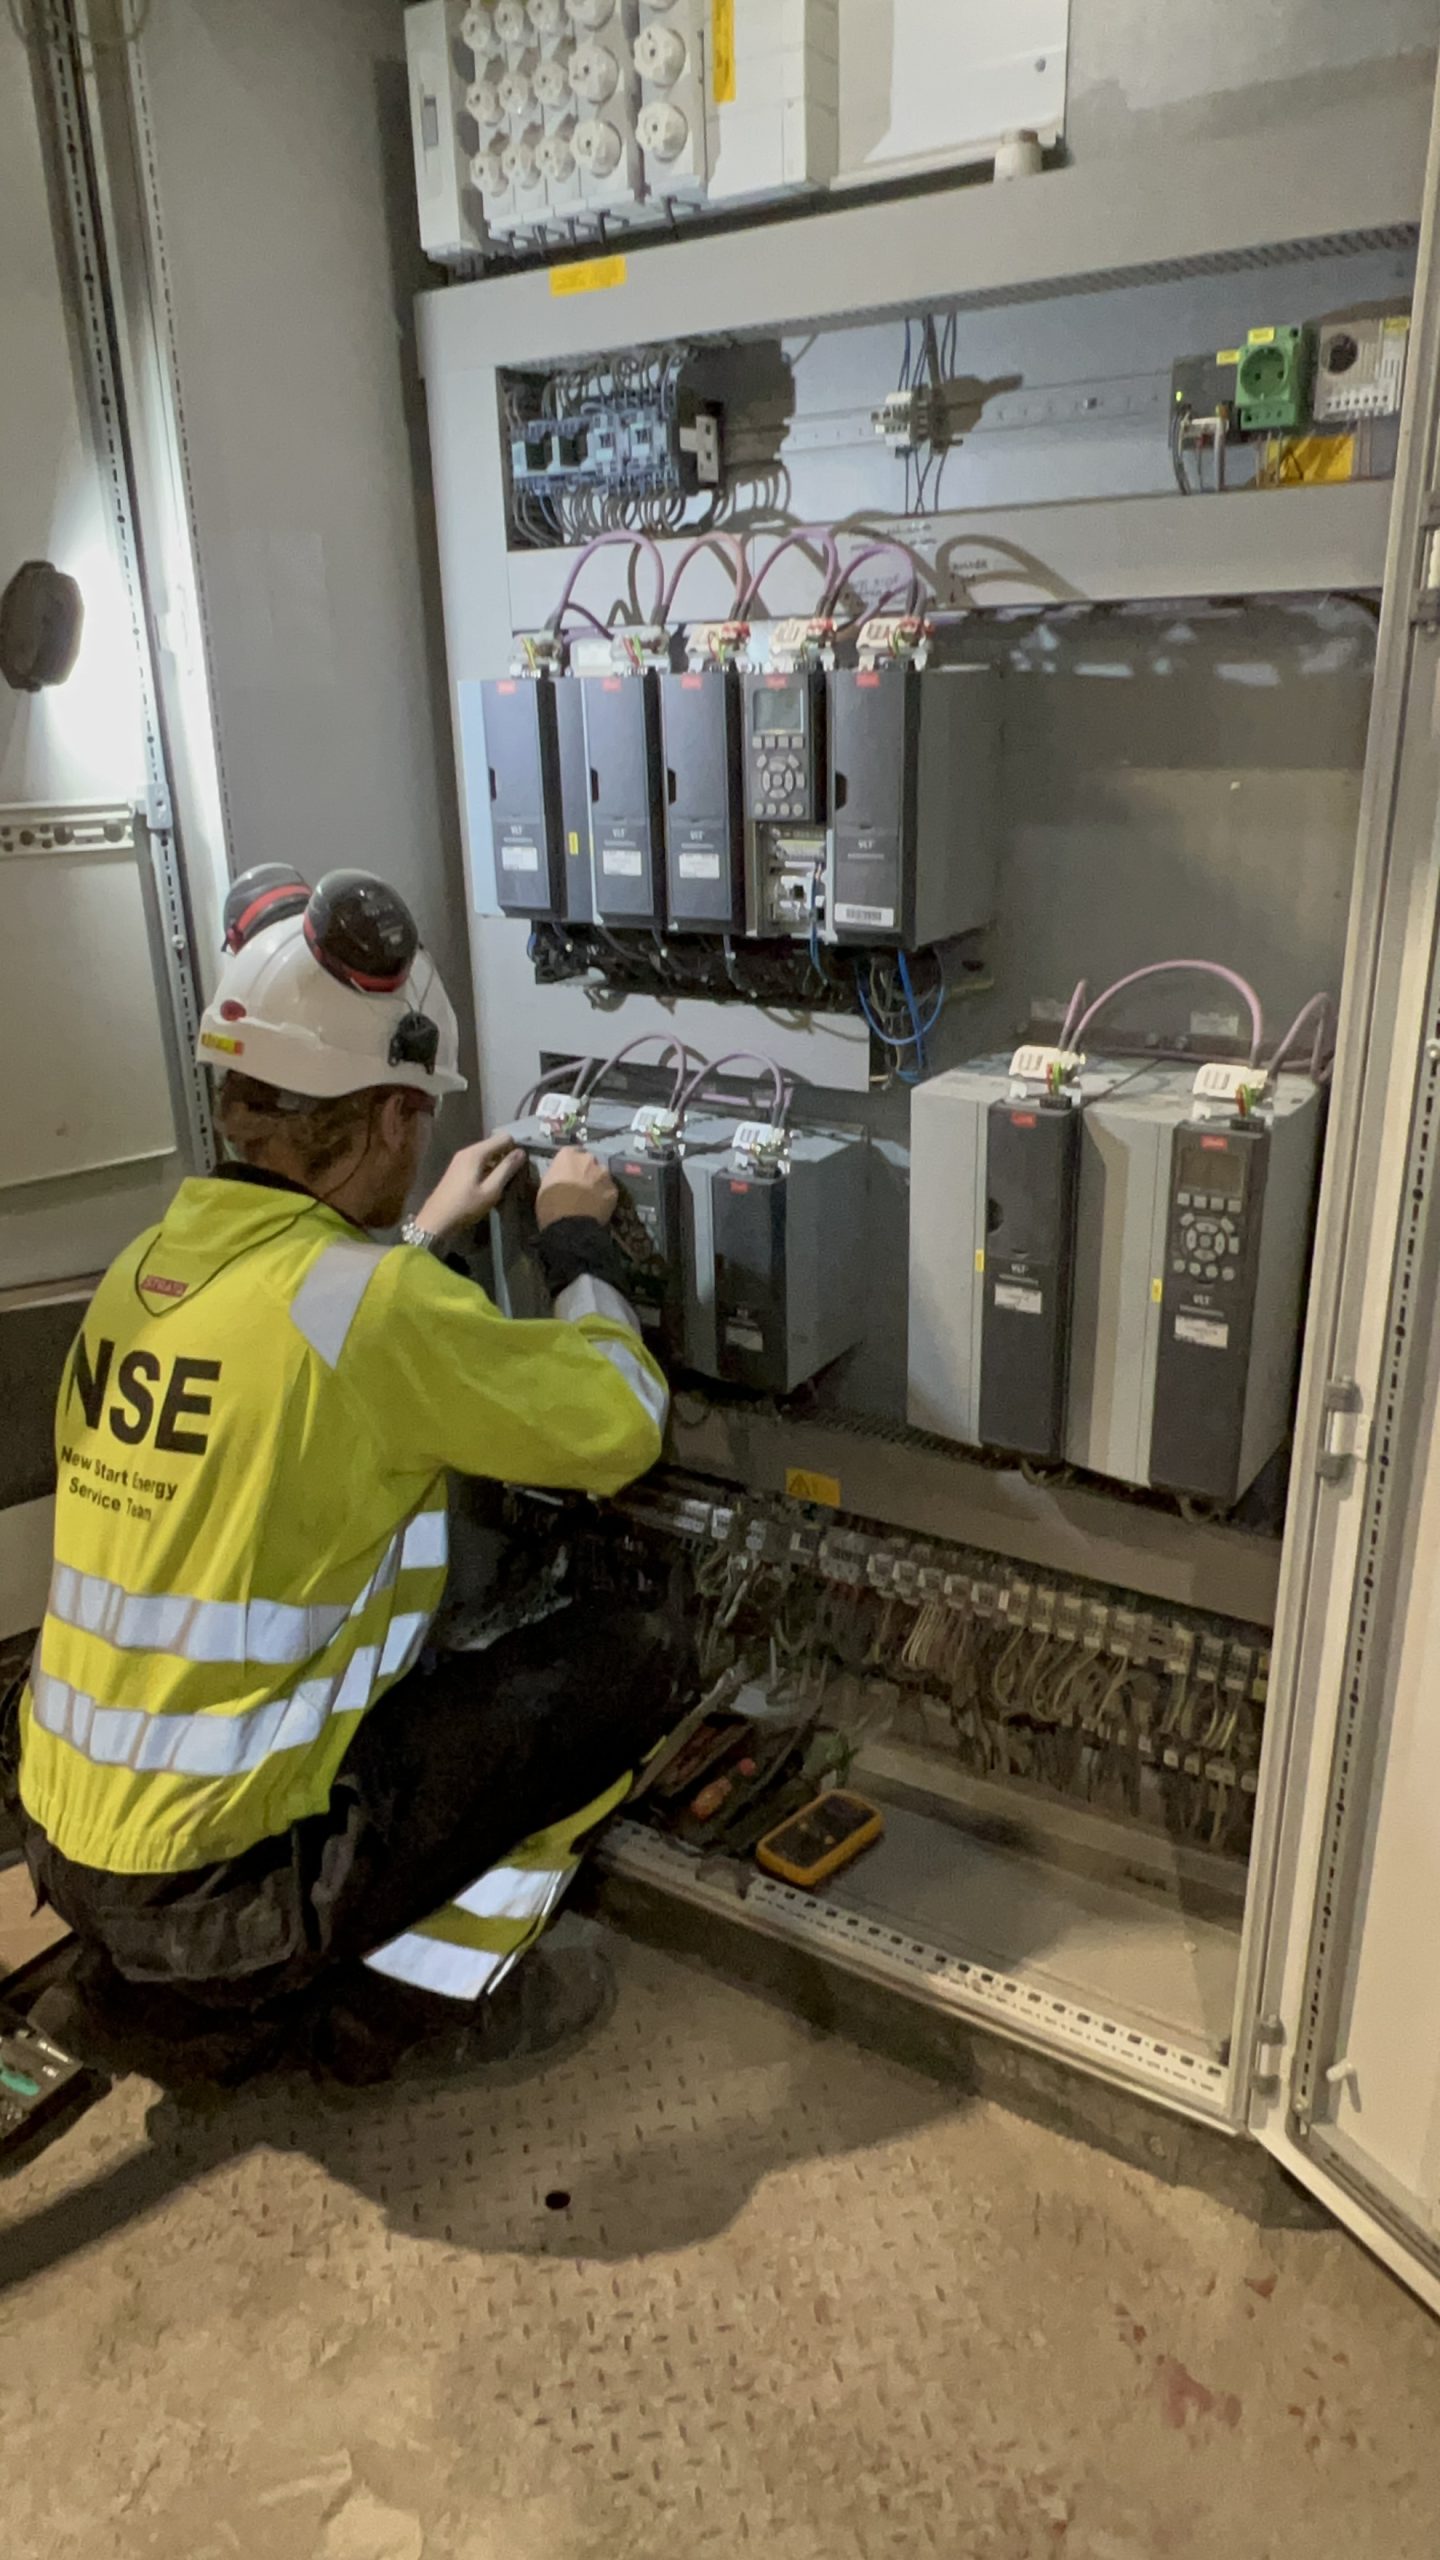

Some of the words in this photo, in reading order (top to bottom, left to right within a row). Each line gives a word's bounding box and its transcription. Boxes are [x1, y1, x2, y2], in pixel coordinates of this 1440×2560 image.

[66, 1330, 222, 1456] NSE
[61, 1445, 92, 1470] New
[95, 1459, 129, 1486] Start
[132, 1471, 178, 1501] Energy
[69, 1476, 122, 1512] Service
[126, 1497, 152, 1521] Team
